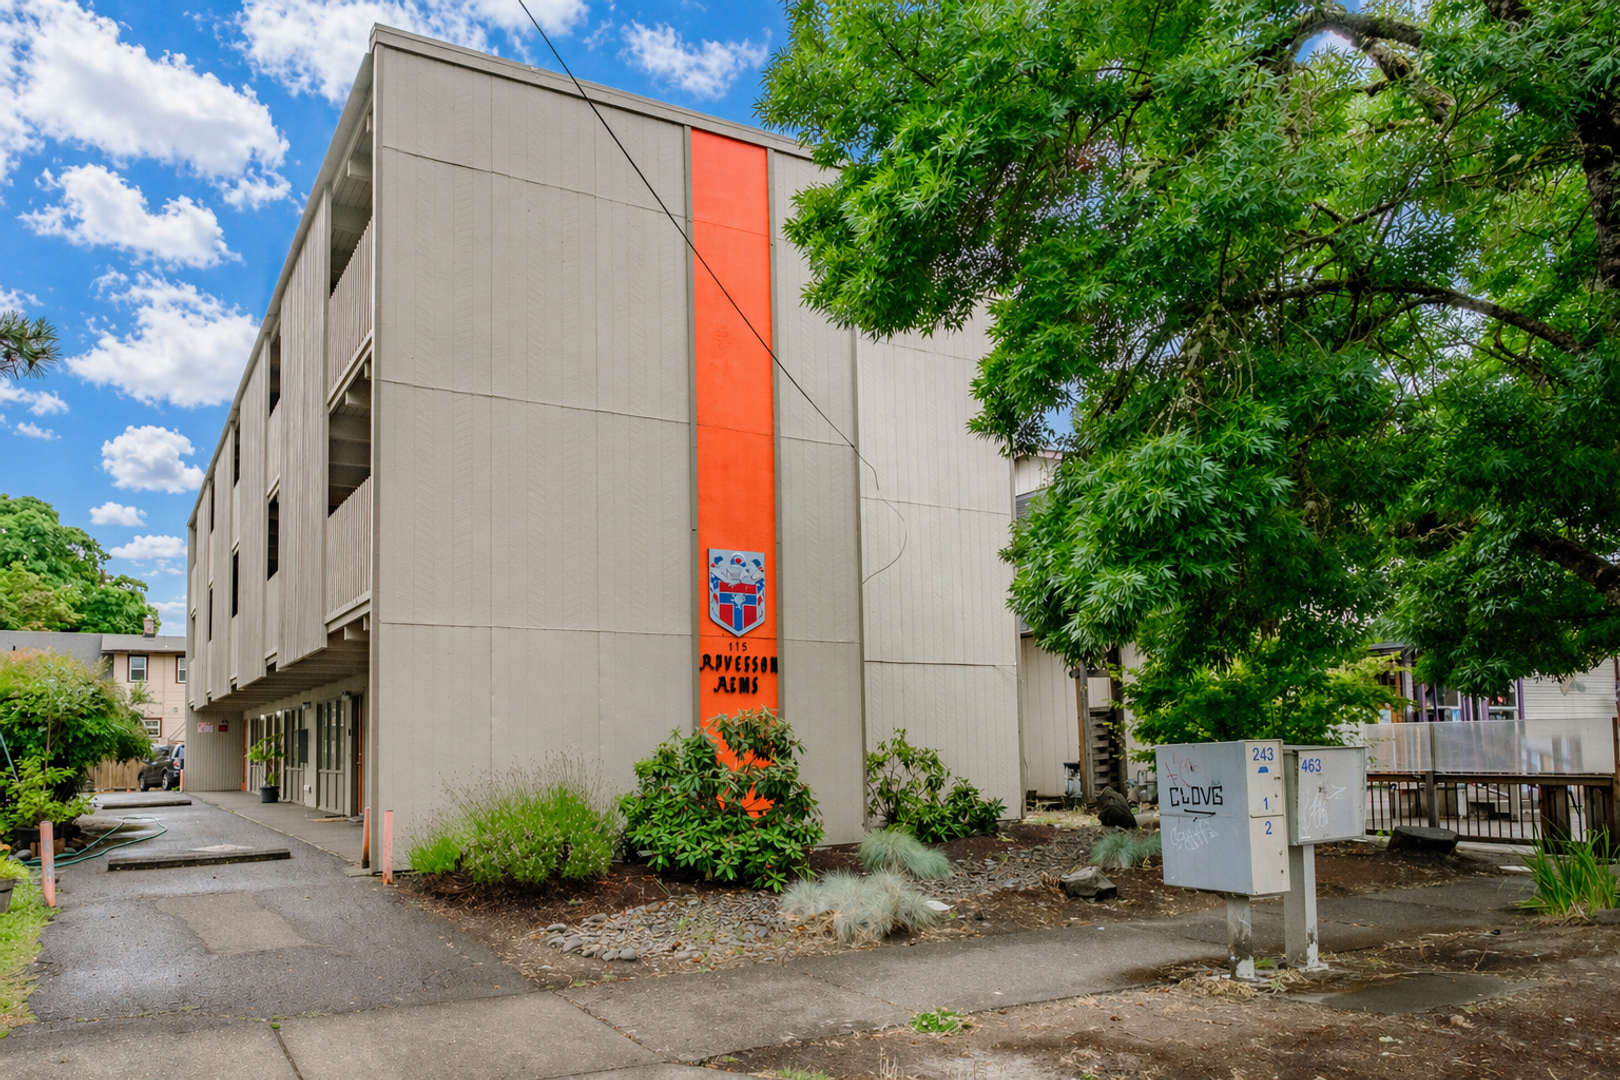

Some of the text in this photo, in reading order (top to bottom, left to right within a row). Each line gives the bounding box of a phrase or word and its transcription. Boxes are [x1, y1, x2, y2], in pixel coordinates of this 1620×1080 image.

[728, 641, 748, 652] 115
[1252, 747, 1274, 761] 243
[1301, 758, 1322, 773] 463
[1263, 796, 1269, 810] 1
[1264, 820, 1273, 835] 2
